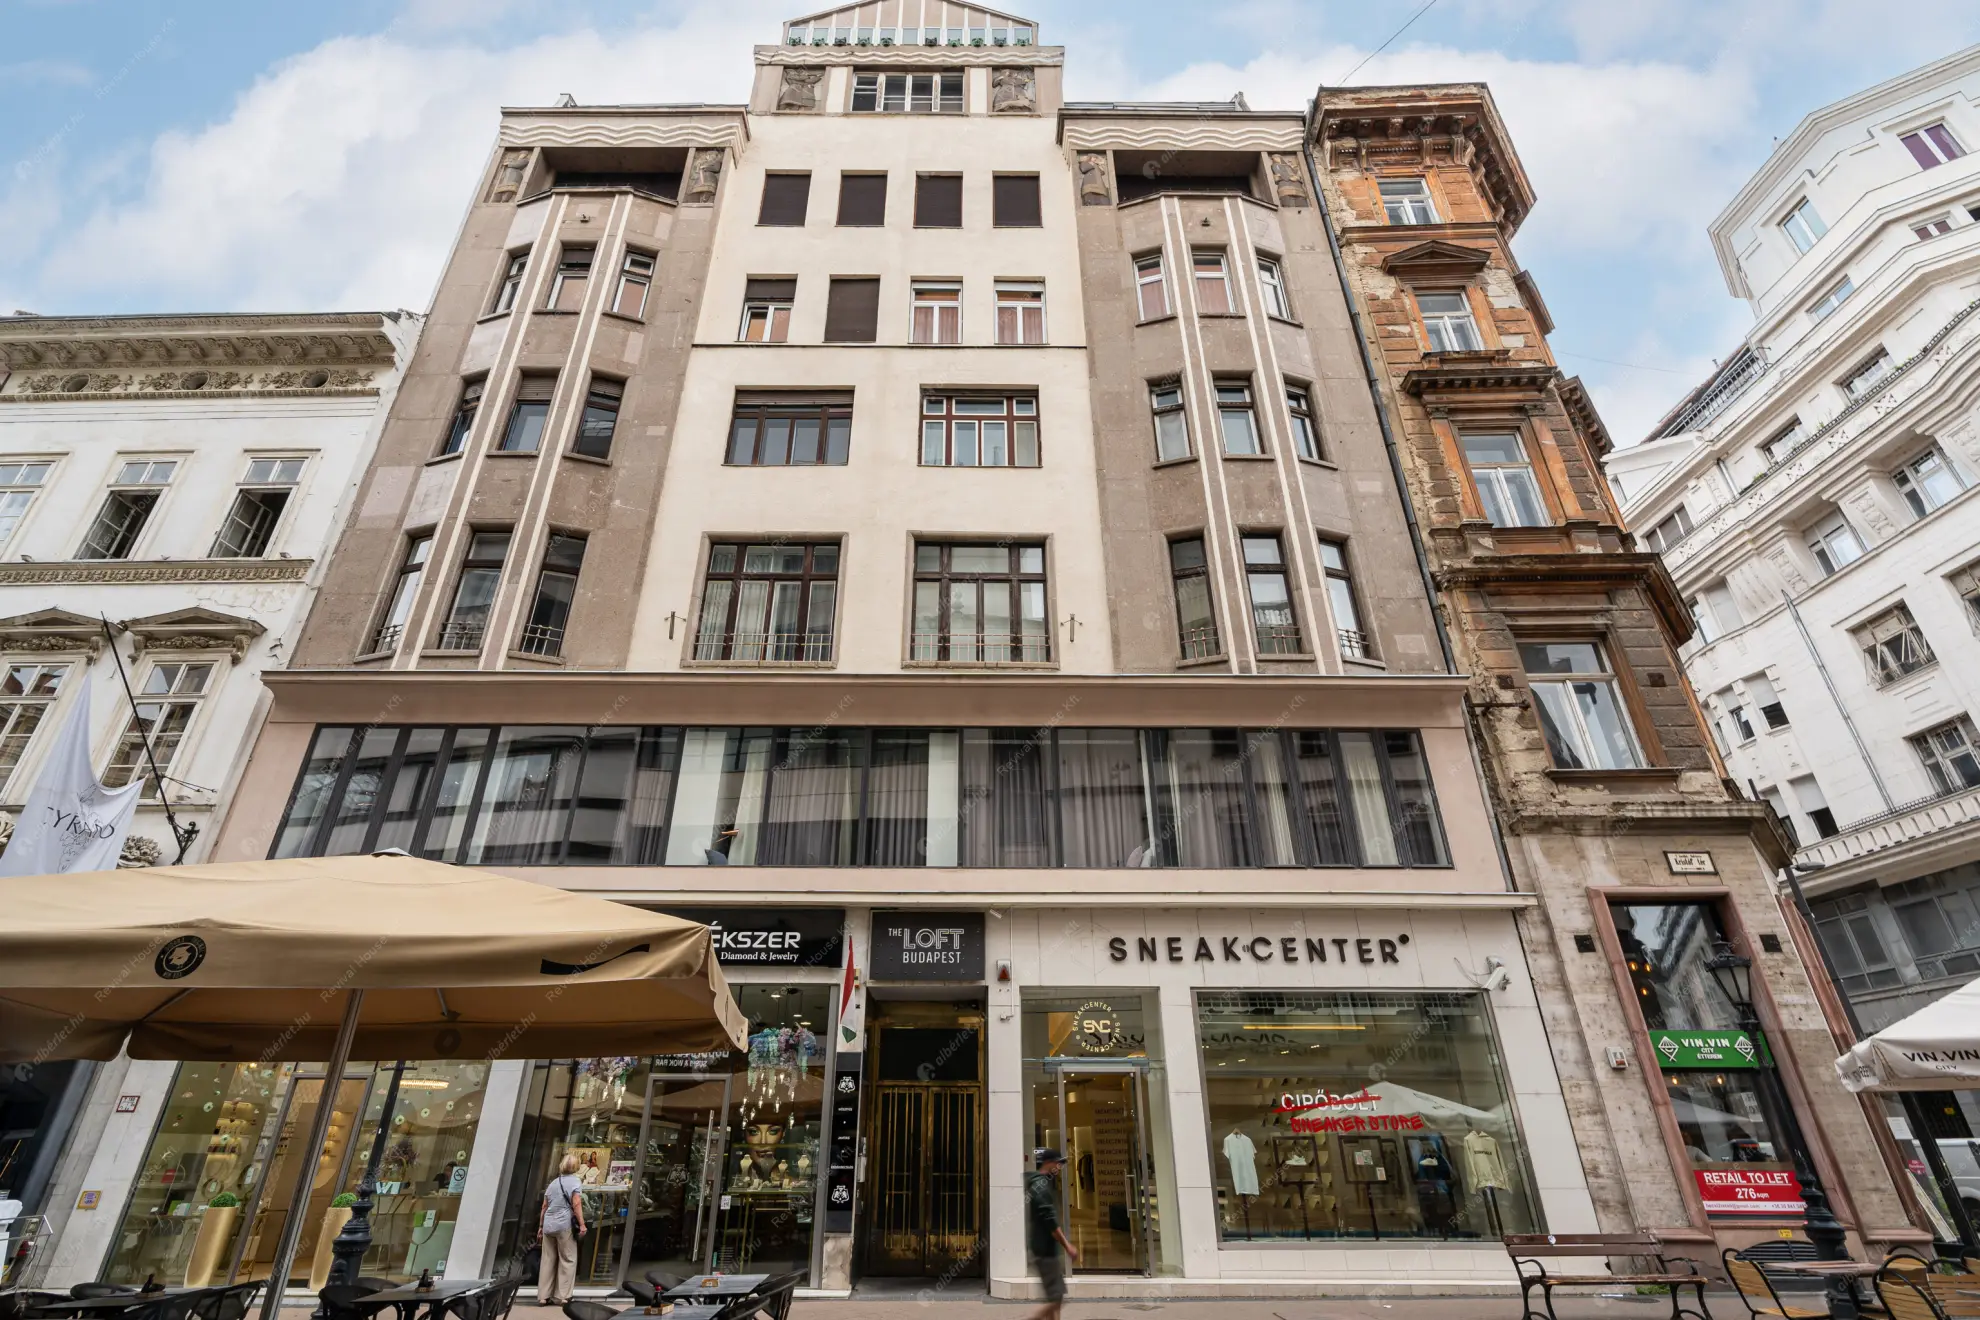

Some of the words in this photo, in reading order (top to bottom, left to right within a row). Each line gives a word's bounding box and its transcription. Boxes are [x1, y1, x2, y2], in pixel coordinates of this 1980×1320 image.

[709, 921, 801, 948] ÉKSZER
[888, 928, 902, 936] THE
[903, 928, 964, 949] LOFT
[721, 952, 758, 960] Diamond
[760, 952, 767, 960] &
[769, 952, 799, 962] Jewelry
[903, 952, 961, 963] BUDAPEST
[1083, 1020, 1111, 1033] SNC
[1681, 1039, 1730, 1048] VIN.VIN
[1902, 1049, 1980, 1062] VIN.VIN
[1704, 1173, 1746, 1183] RETAIL
[1747, 1173, 1765, 1183] TO
[1766, 1173, 1789, 1184] LET
